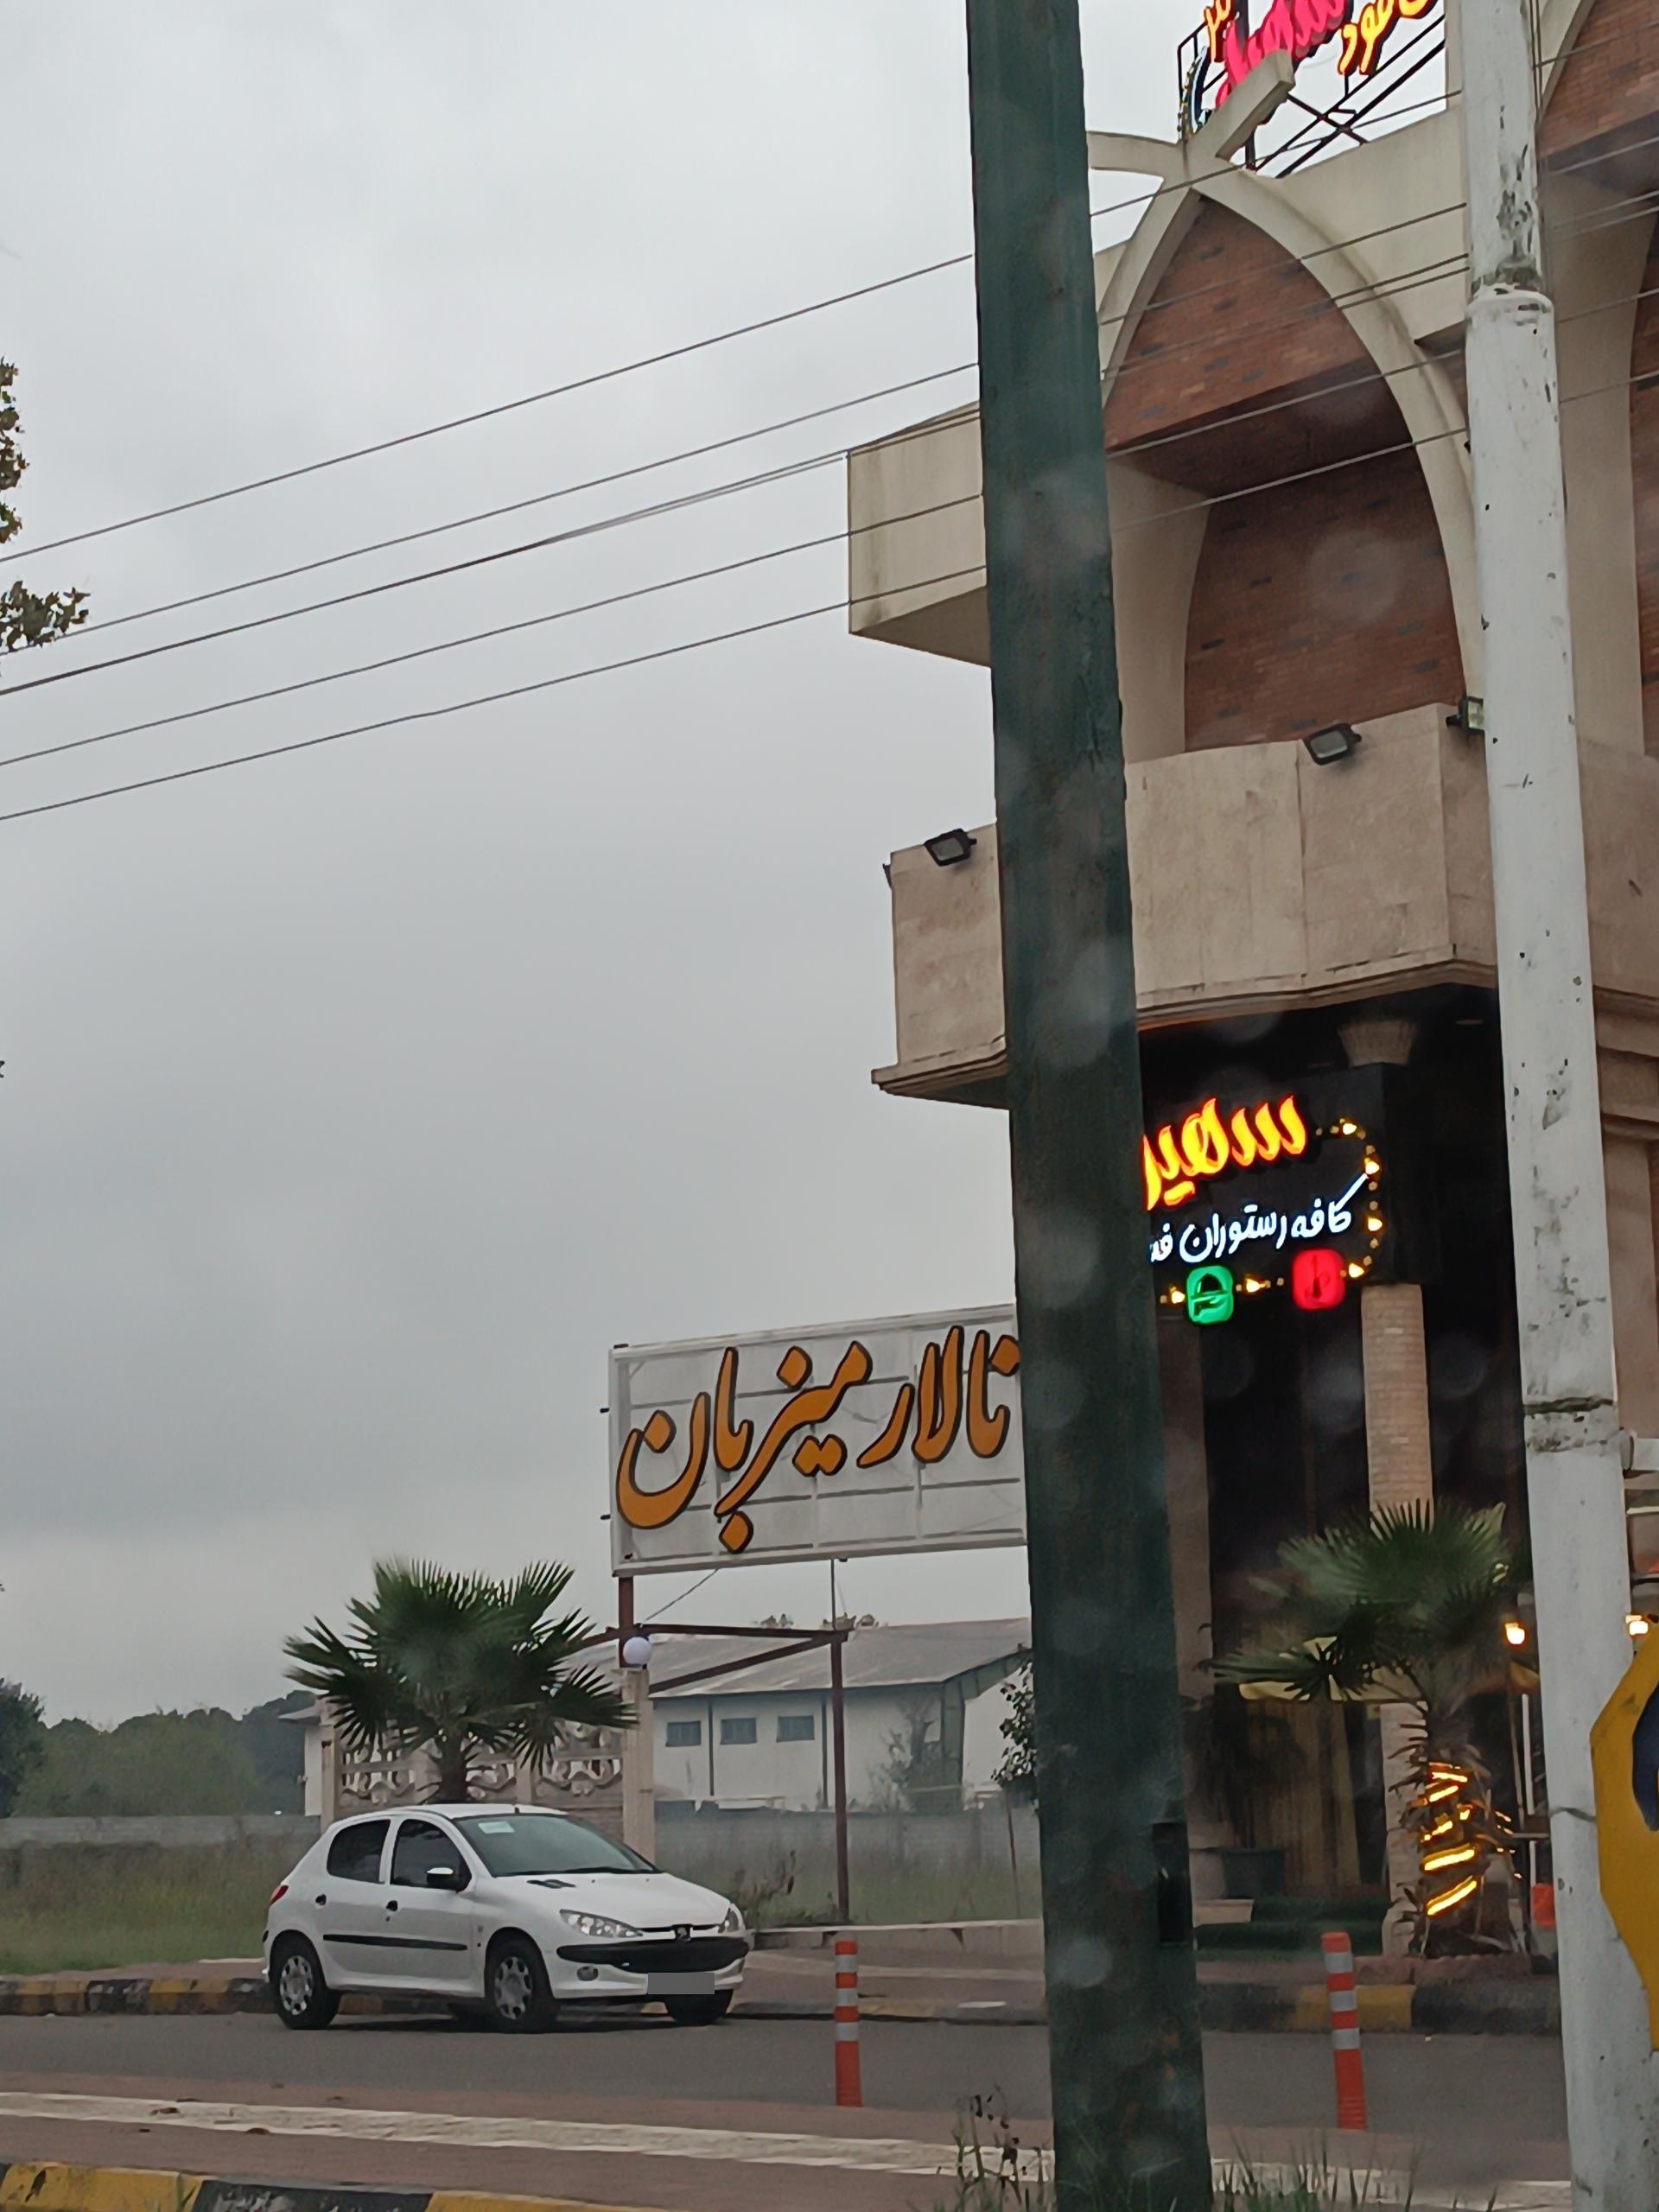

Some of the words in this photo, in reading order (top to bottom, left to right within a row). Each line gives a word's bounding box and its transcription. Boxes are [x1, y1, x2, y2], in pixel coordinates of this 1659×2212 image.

[1179, 1204, 1287, 1263] رستوران
[1291, 1173, 1370, 1238] کافه
[616, 1340, 873, 1554] میزبان
